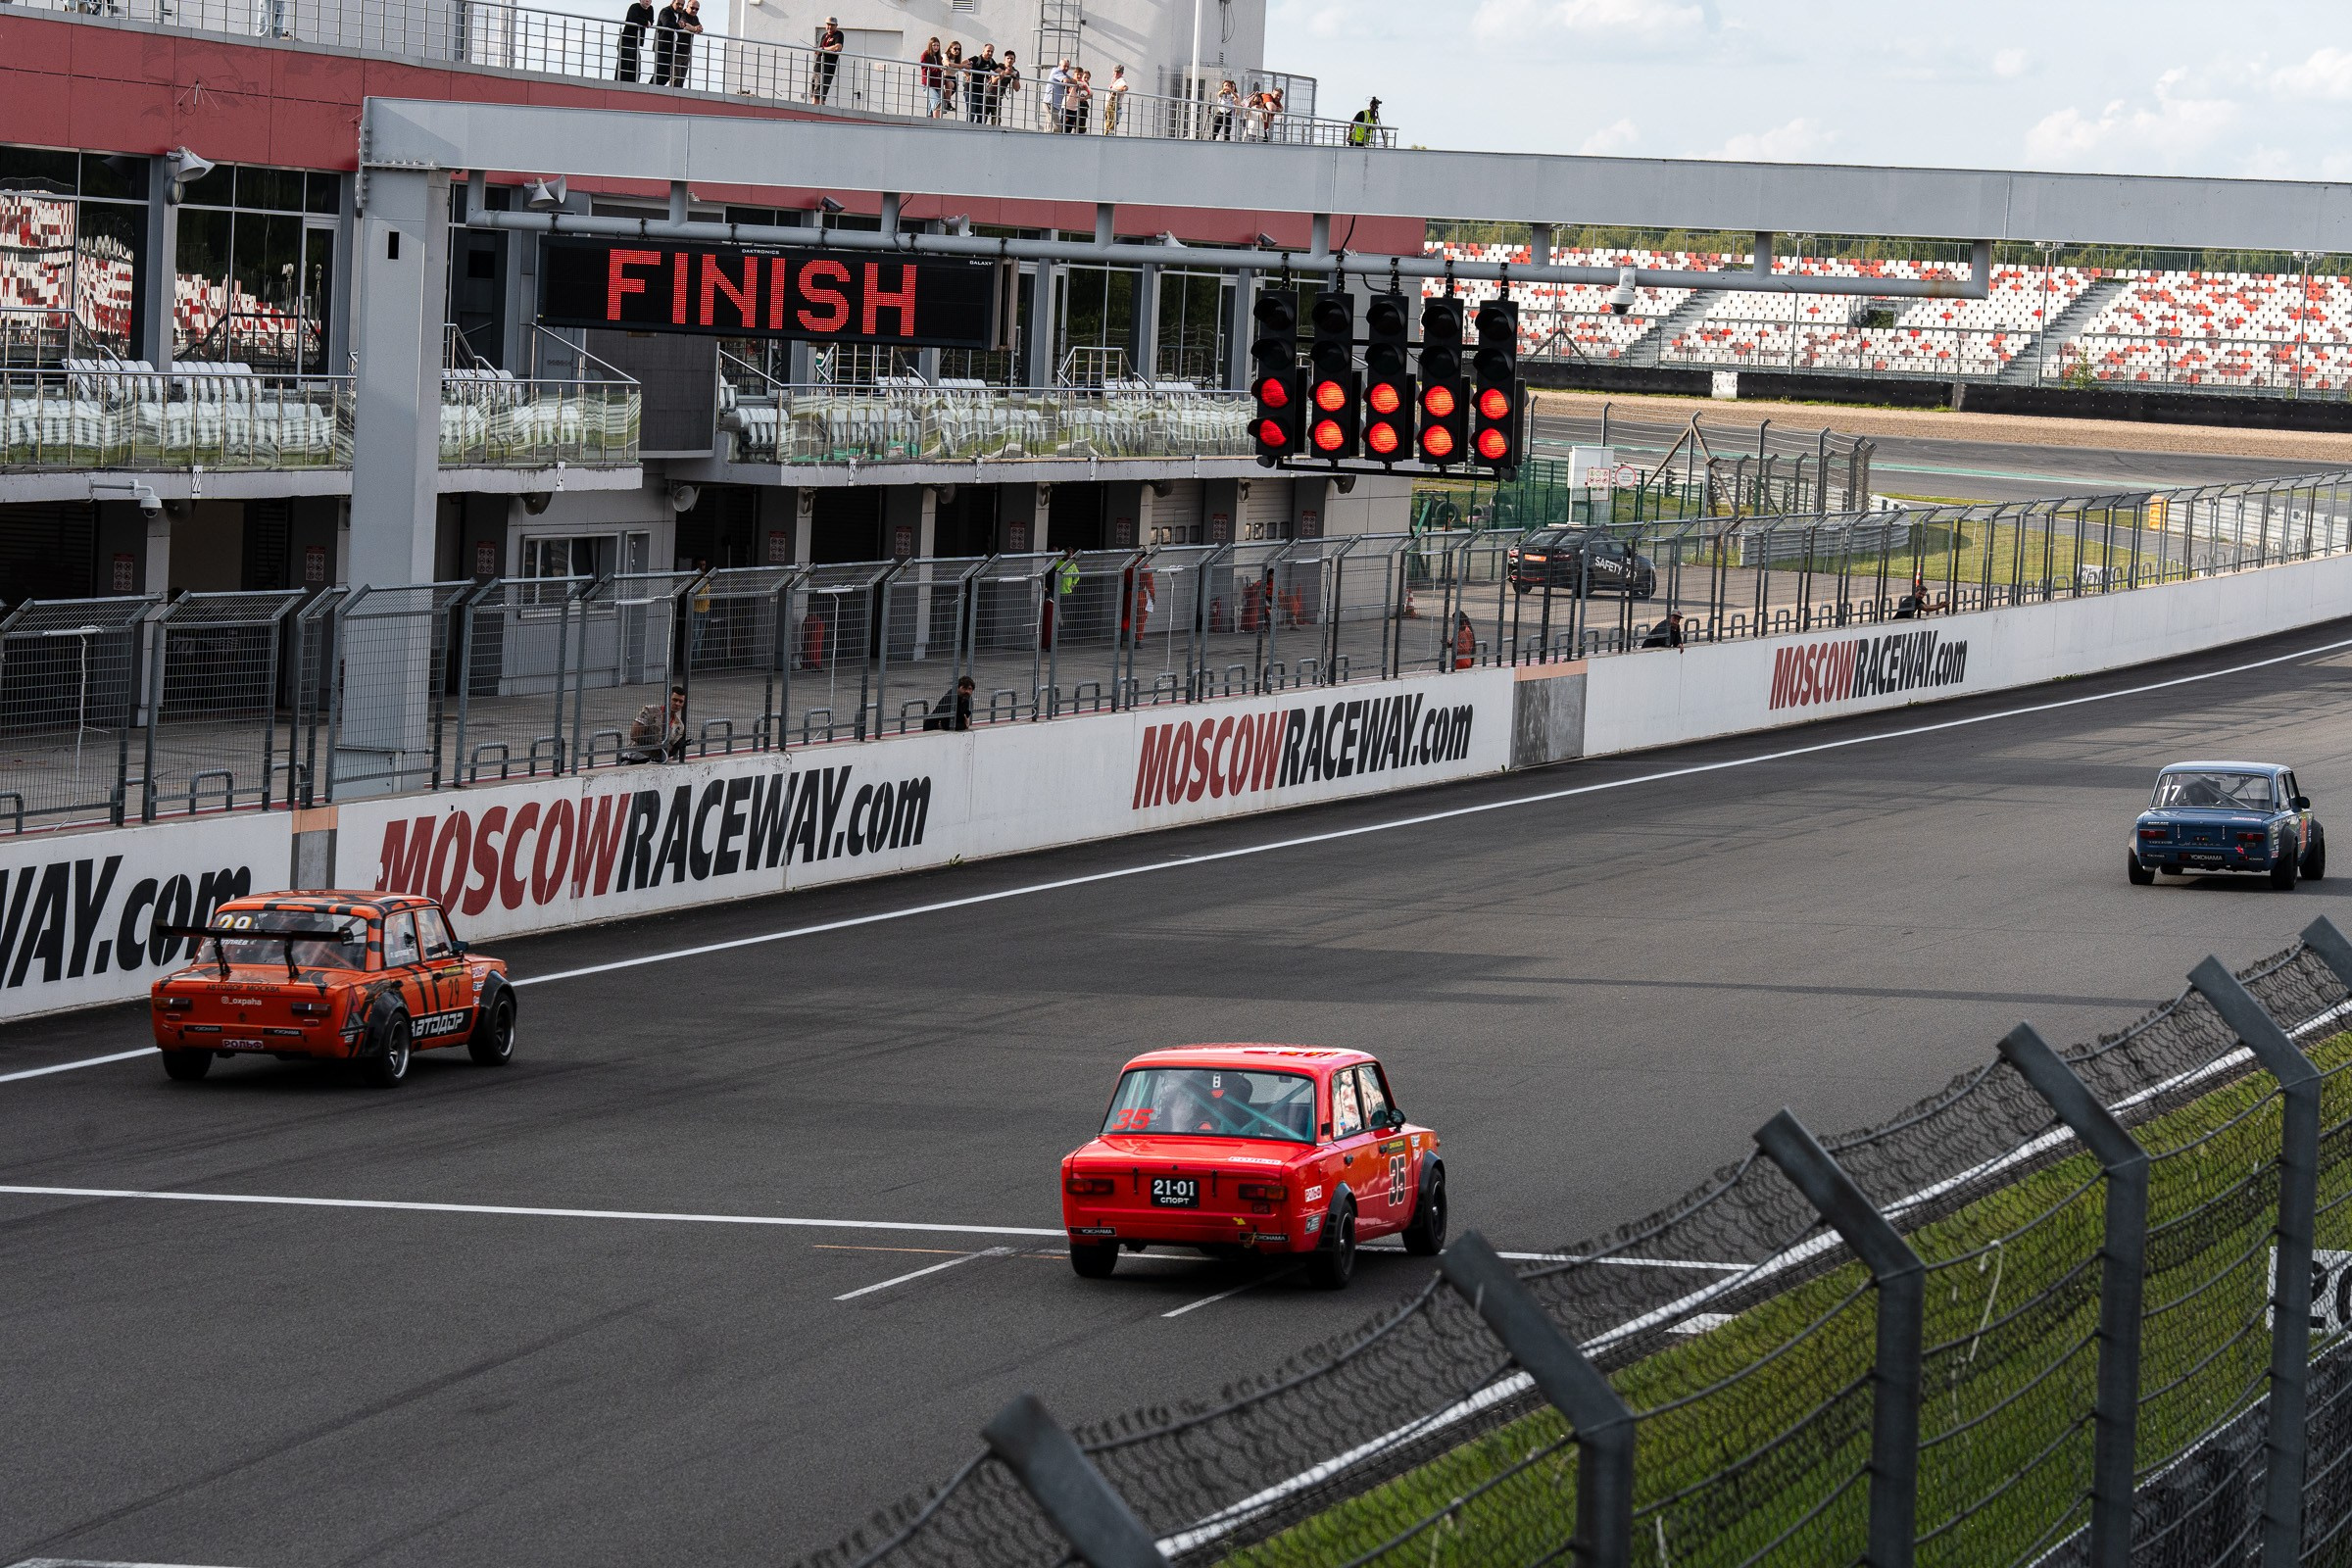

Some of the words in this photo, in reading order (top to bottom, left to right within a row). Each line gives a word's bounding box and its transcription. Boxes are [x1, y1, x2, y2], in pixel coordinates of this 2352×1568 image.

[607, 248, 917, 337] FINISH
[192, 470, 202, 494] 22
[1594, 556, 1623, 575] SAFETY
[1769, 629, 1968, 710] MOSCOWRACEWAY.com
[1132, 692, 1474, 810] MOSCOWRACEWAY.com
[2162, 784, 2181, 802] 17
[374, 764, 932, 917] MOSCOWRACEWAY.com
[246, 984, 280, 993] МОСКВА
[447, 978, 461, 1007] 29
[411, 1012, 464, 1037] АВТОДОР
[223, 1040, 263, 1049] РОЛЬФ
[1111, 1108, 1153, 1130] 35
[1153, 1179, 1195, 1197] 21-01
[1388, 1153, 1406, 1207] 35
